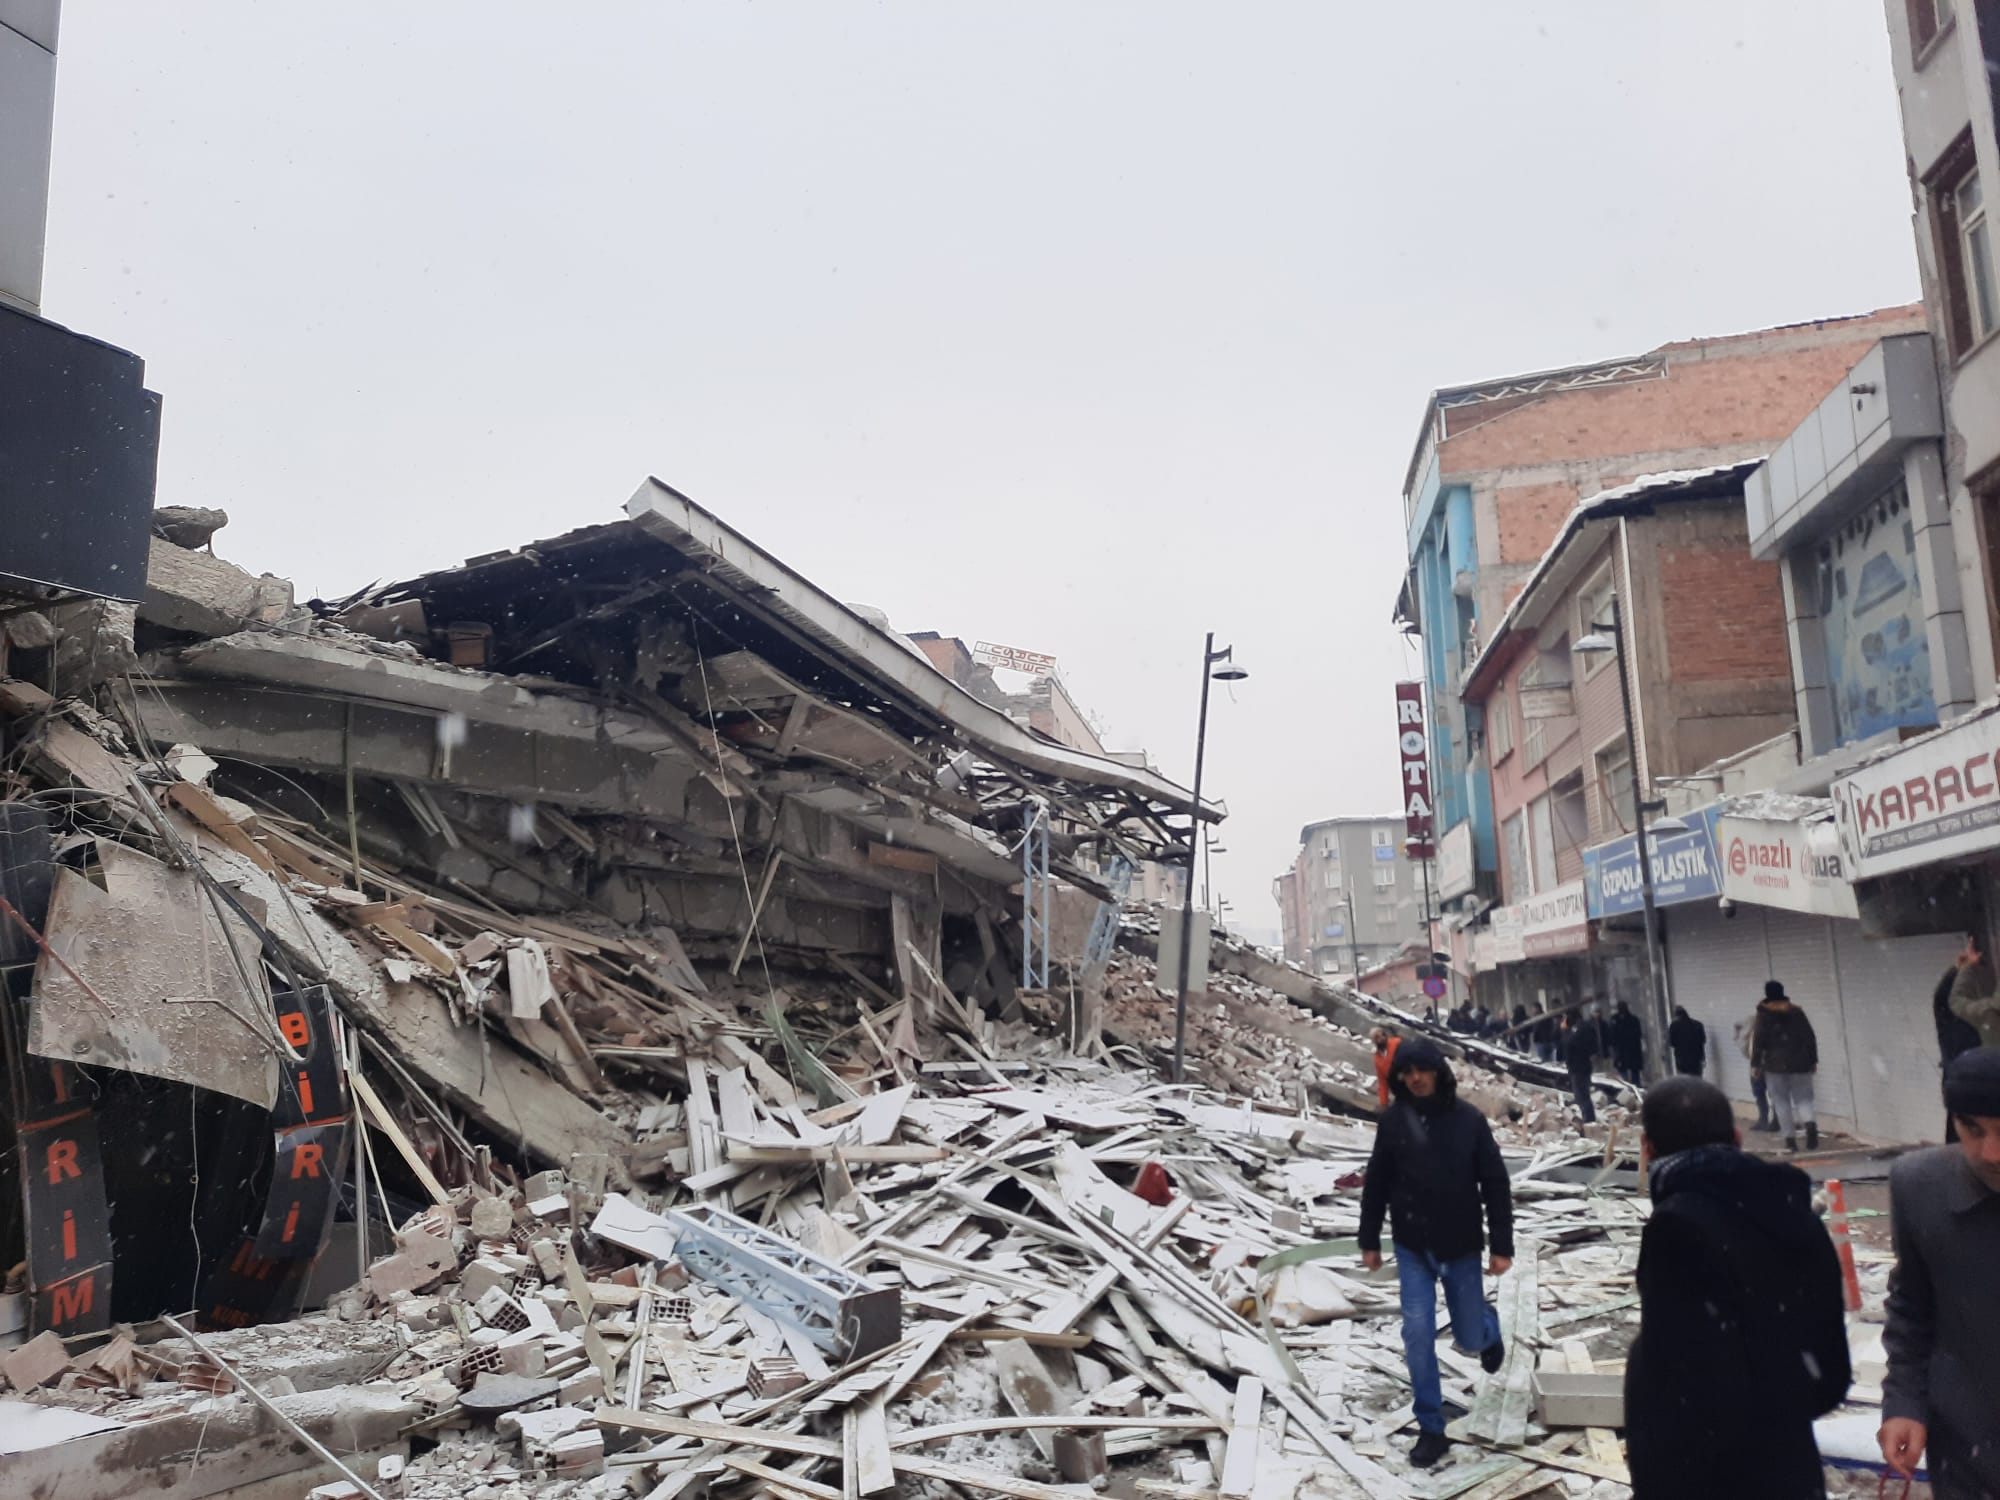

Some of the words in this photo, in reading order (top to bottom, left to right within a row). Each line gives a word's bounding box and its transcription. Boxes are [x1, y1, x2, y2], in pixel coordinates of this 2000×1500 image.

[1398, 699, 1433, 817] ROTA
[1857, 748, 2000, 834] KARAC
[1602, 863, 1645, 898] ÖZPOLA
[1651, 838, 1709, 885] PLASTİK
[1749, 838, 1792, 870] nazlı
